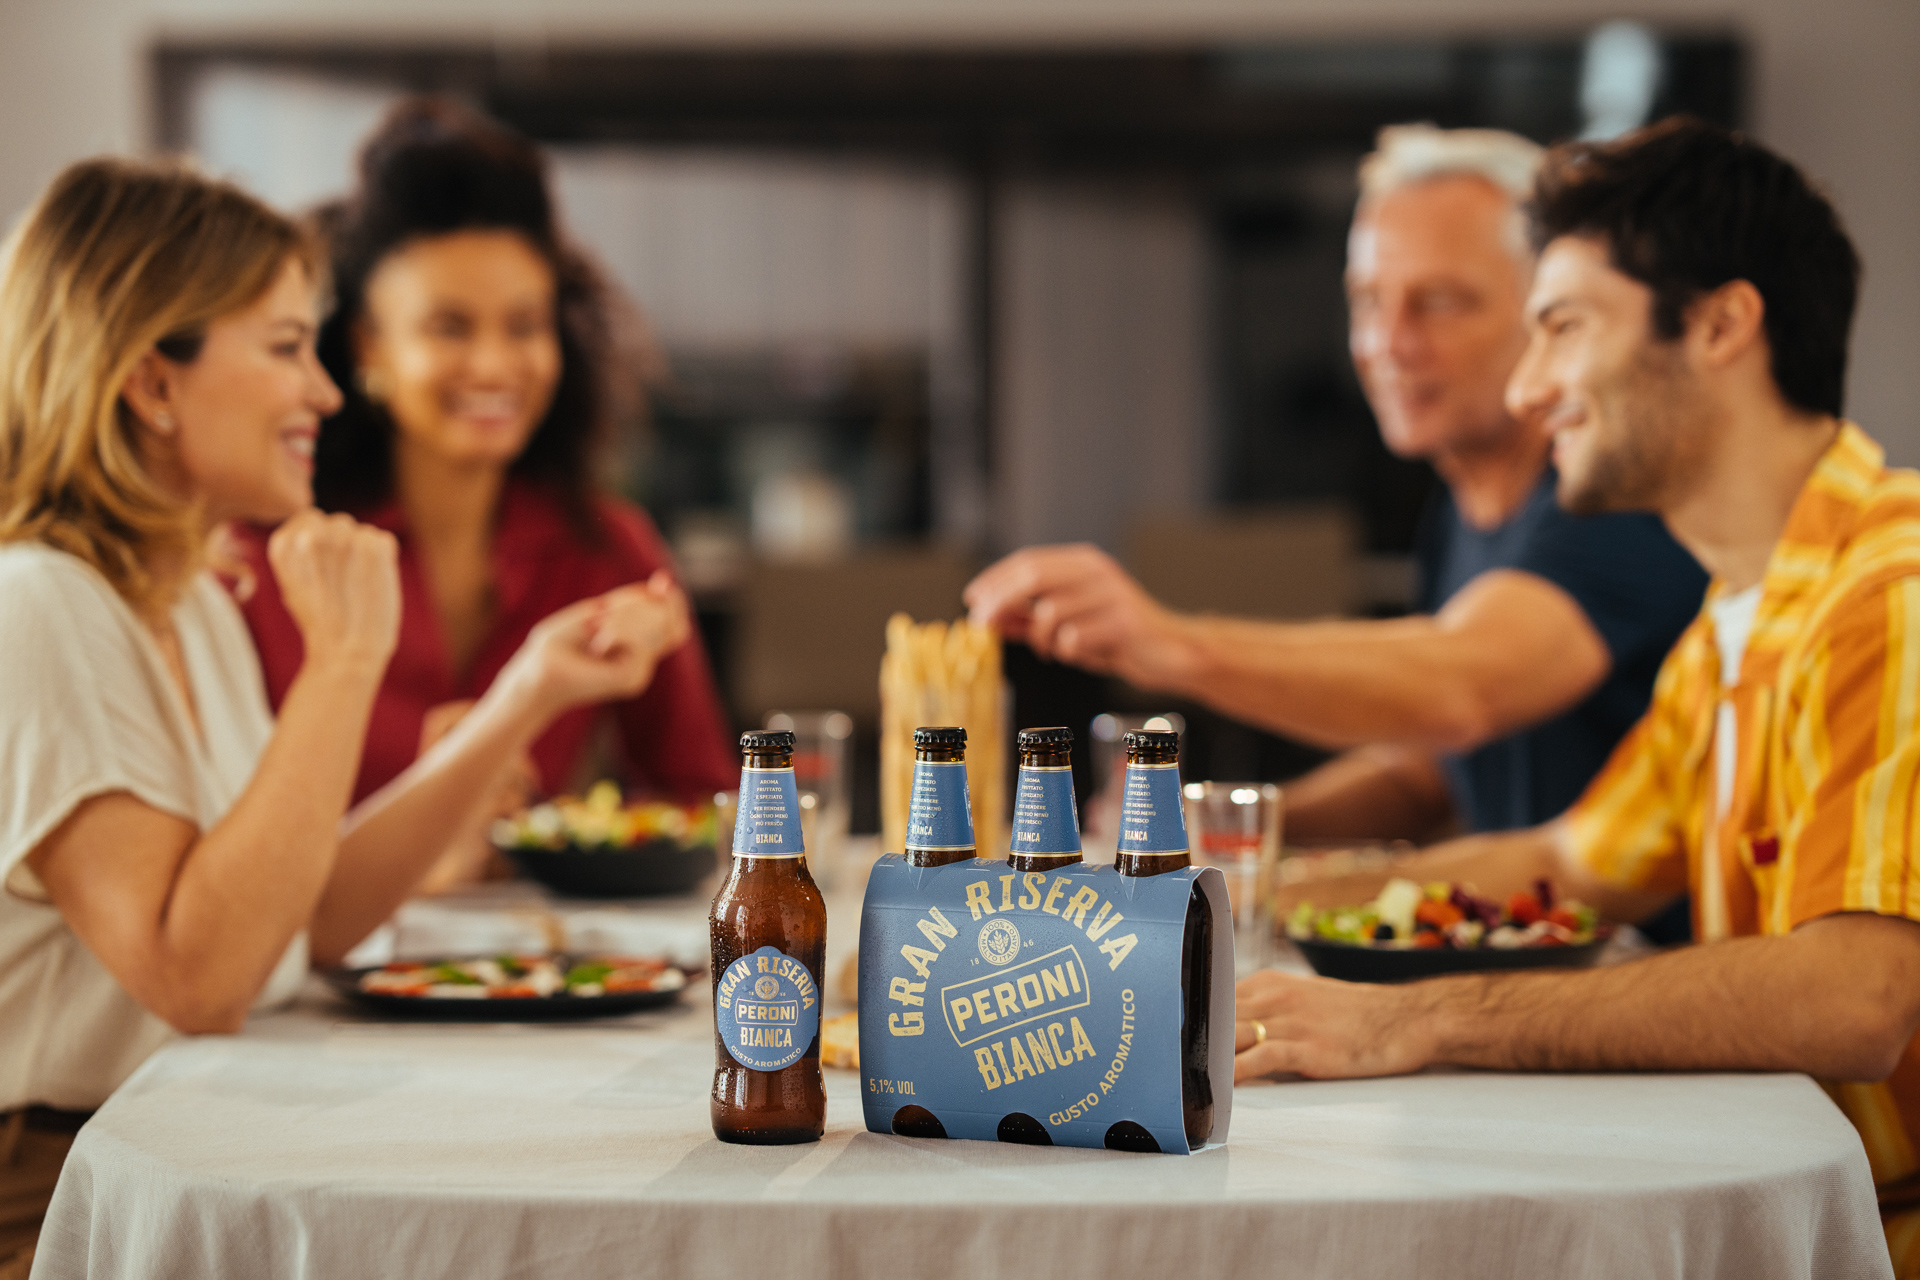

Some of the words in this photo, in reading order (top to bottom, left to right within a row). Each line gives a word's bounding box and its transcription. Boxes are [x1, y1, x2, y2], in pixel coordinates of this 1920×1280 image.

[756, 833, 783, 844] BIANCA
[1017, 832, 1040, 842] BIANCA
[1124, 830, 1148, 841] BIANCA
[985, 921, 1005, 933] 100%
[888, 906, 958, 1037] GRAN
[965, 872, 1139, 971] RISERVA
[970, 957, 979, 966] 18
[1023, 939, 1034, 948] 46
[981, 939, 998, 962] MALTO
[999, 928, 1018, 962] ITALIANO
[720, 960, 751, 1009] GRAN
[757, 956, 815, 1010] RISERVA
[950, 960, 1081, 1032] PERONI
[738, 1004, 795, 1020] PERONI
[741, 1026, 792, 1048] BIANCA
[731, 1045, 753, 1064] GUSTO
[754, 1047, 802, 1067] AROMATICO
[973, 1016, 1097, 1091] BIANCA
[1049, 1092, 1099, 1126] GUSTO
[1099, 988, 1136, 1096] AROMATICO
[869, 1078, 895, 1095] 5,1%
[897, 1080, 916, 1095] VOL
